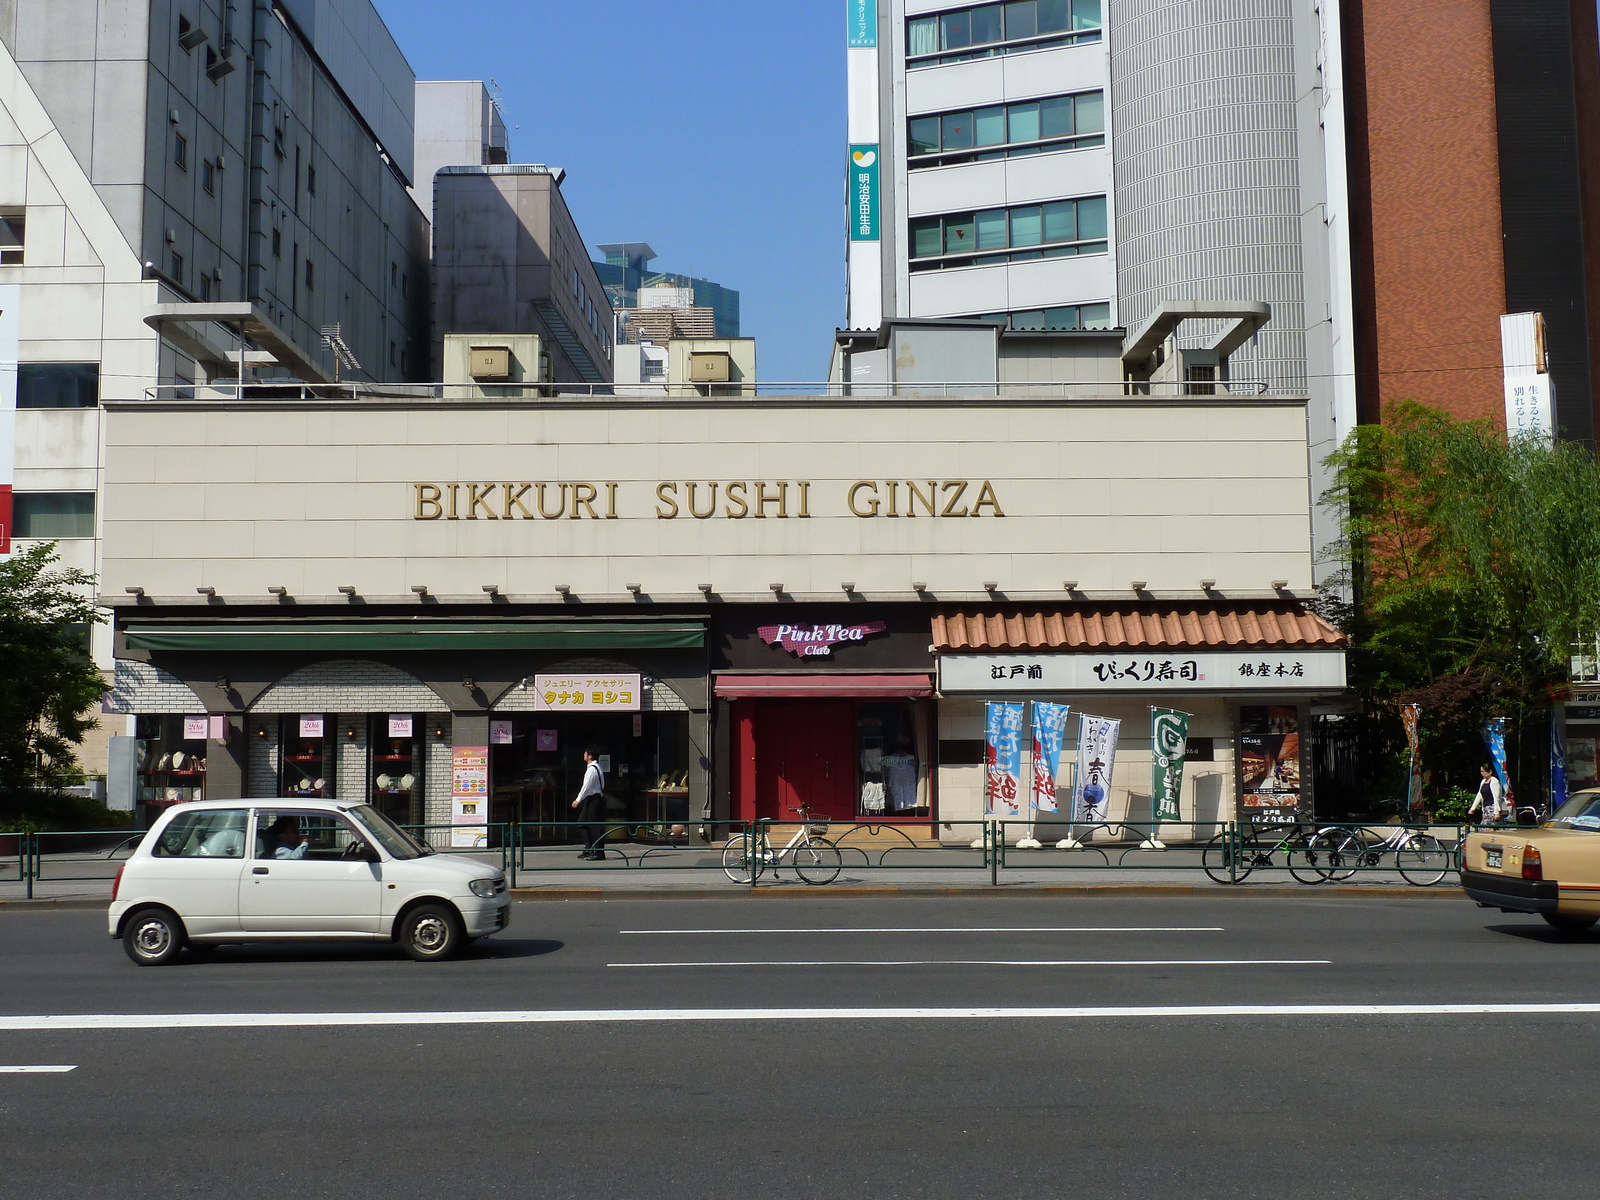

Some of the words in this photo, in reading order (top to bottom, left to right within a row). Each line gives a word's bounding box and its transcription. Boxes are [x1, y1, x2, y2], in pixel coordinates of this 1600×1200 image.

[859, 173, 870, 235] 明治安田生命
[413, 483, 618, 520] BIKKURI
[655, 481, 812, 519] SUSHI
[847, 480, 1005, 518] GINZA
[804, 645, 831, 655] Club
[991, 664, 1042, 680] 江戸前
[1093, 660, 1198, 682] びっくり寿司
[1238, 662, 1304, 677] 銀座本店
[544, 691, 584, 704] タナカ
[592, 691, 632, 704] ヨシコ
[1087, 719, 1099, 754] いわがき
